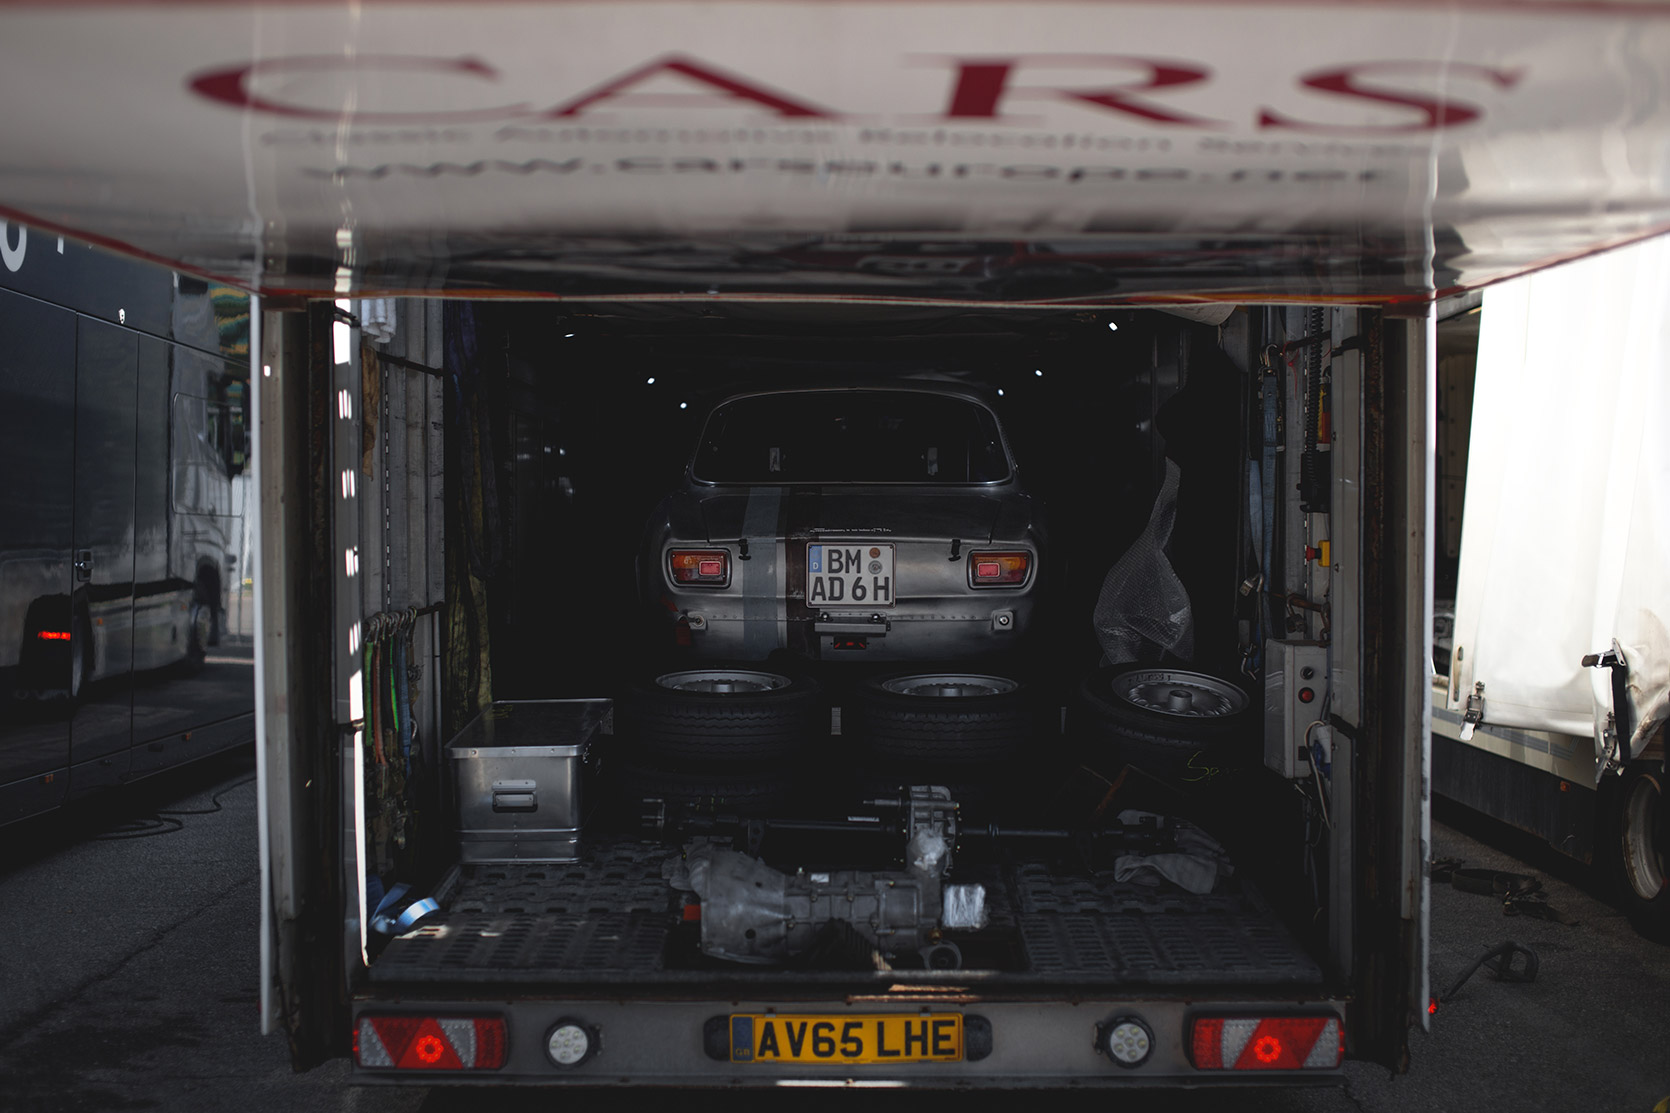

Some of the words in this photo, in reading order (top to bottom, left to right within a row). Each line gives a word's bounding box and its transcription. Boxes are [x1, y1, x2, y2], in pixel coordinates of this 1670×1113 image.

[186, 50, 1525, 136] CARS
[828, 549, 862, 574] BM
[757, 1021, 863, 1058] AV65
[877, 1020, 956, 1057] LHE
